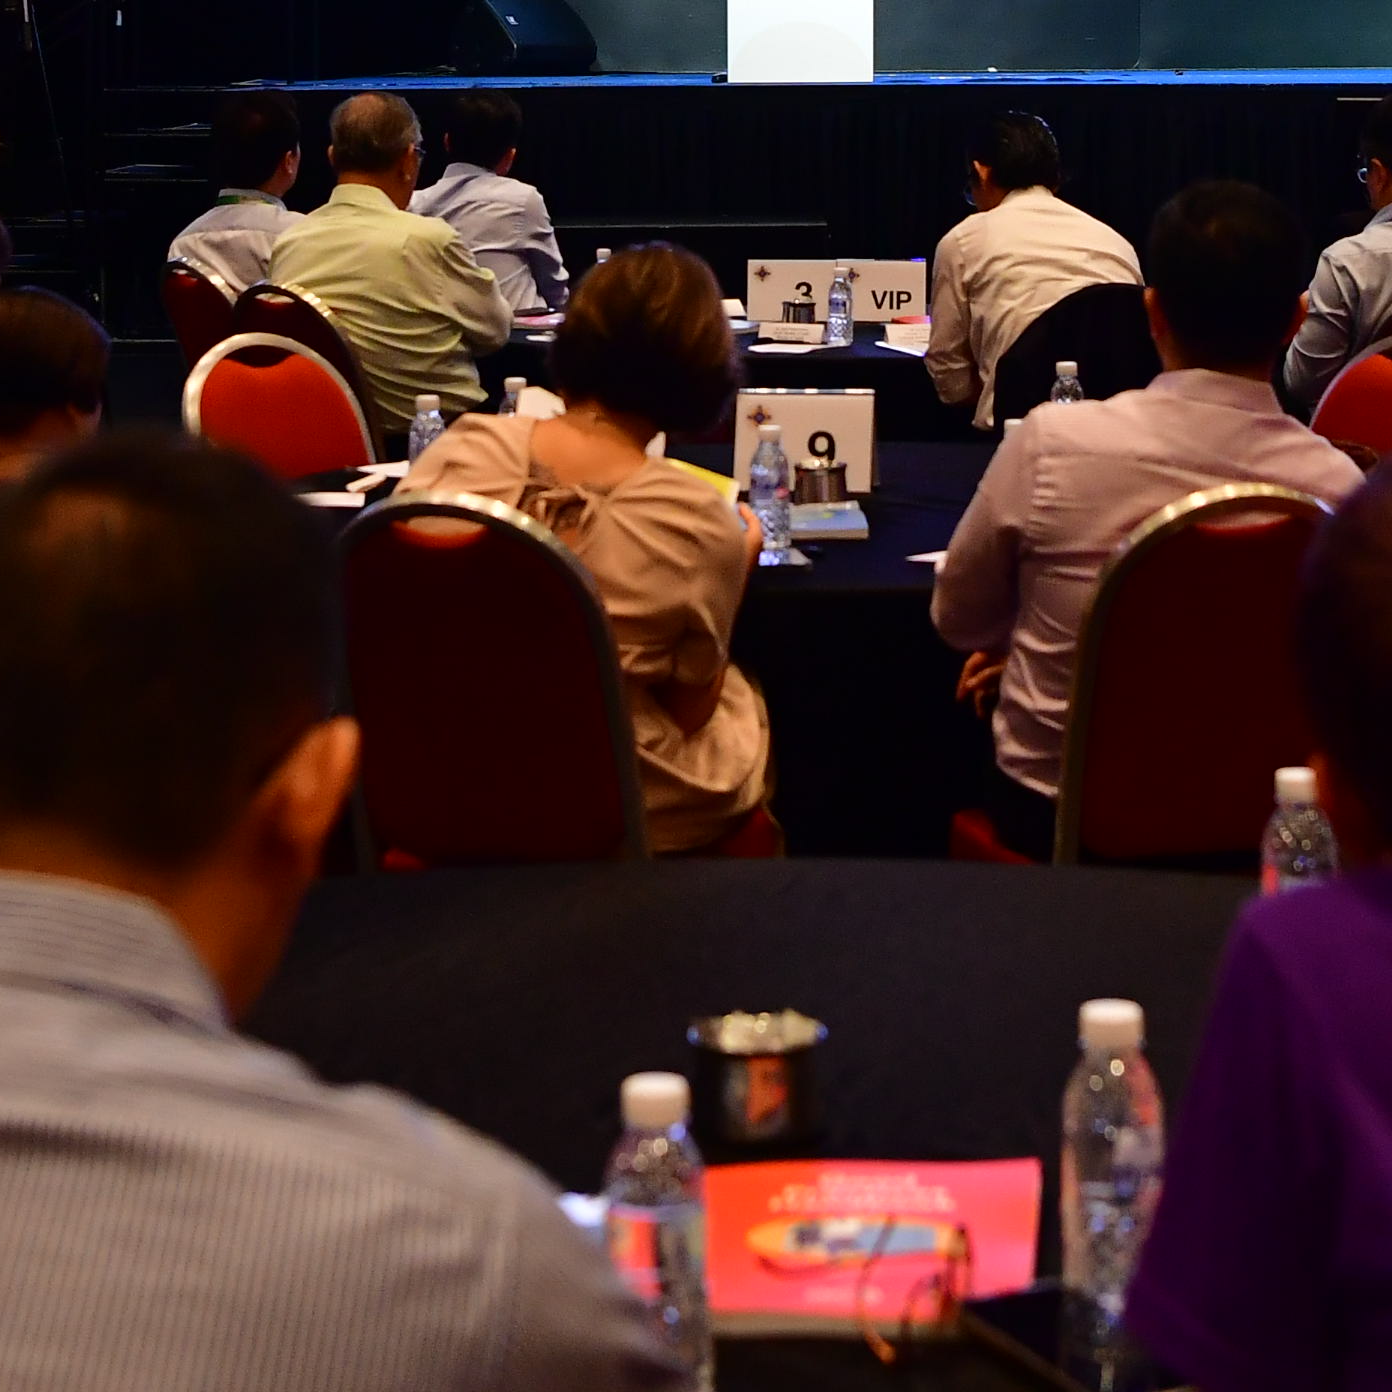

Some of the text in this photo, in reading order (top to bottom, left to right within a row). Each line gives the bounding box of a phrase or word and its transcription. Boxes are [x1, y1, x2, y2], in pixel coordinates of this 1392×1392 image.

[794, 281, 813, 301] 3
[871, 290, 912, 310] VIP
[807, 431, 836, 460] 9
